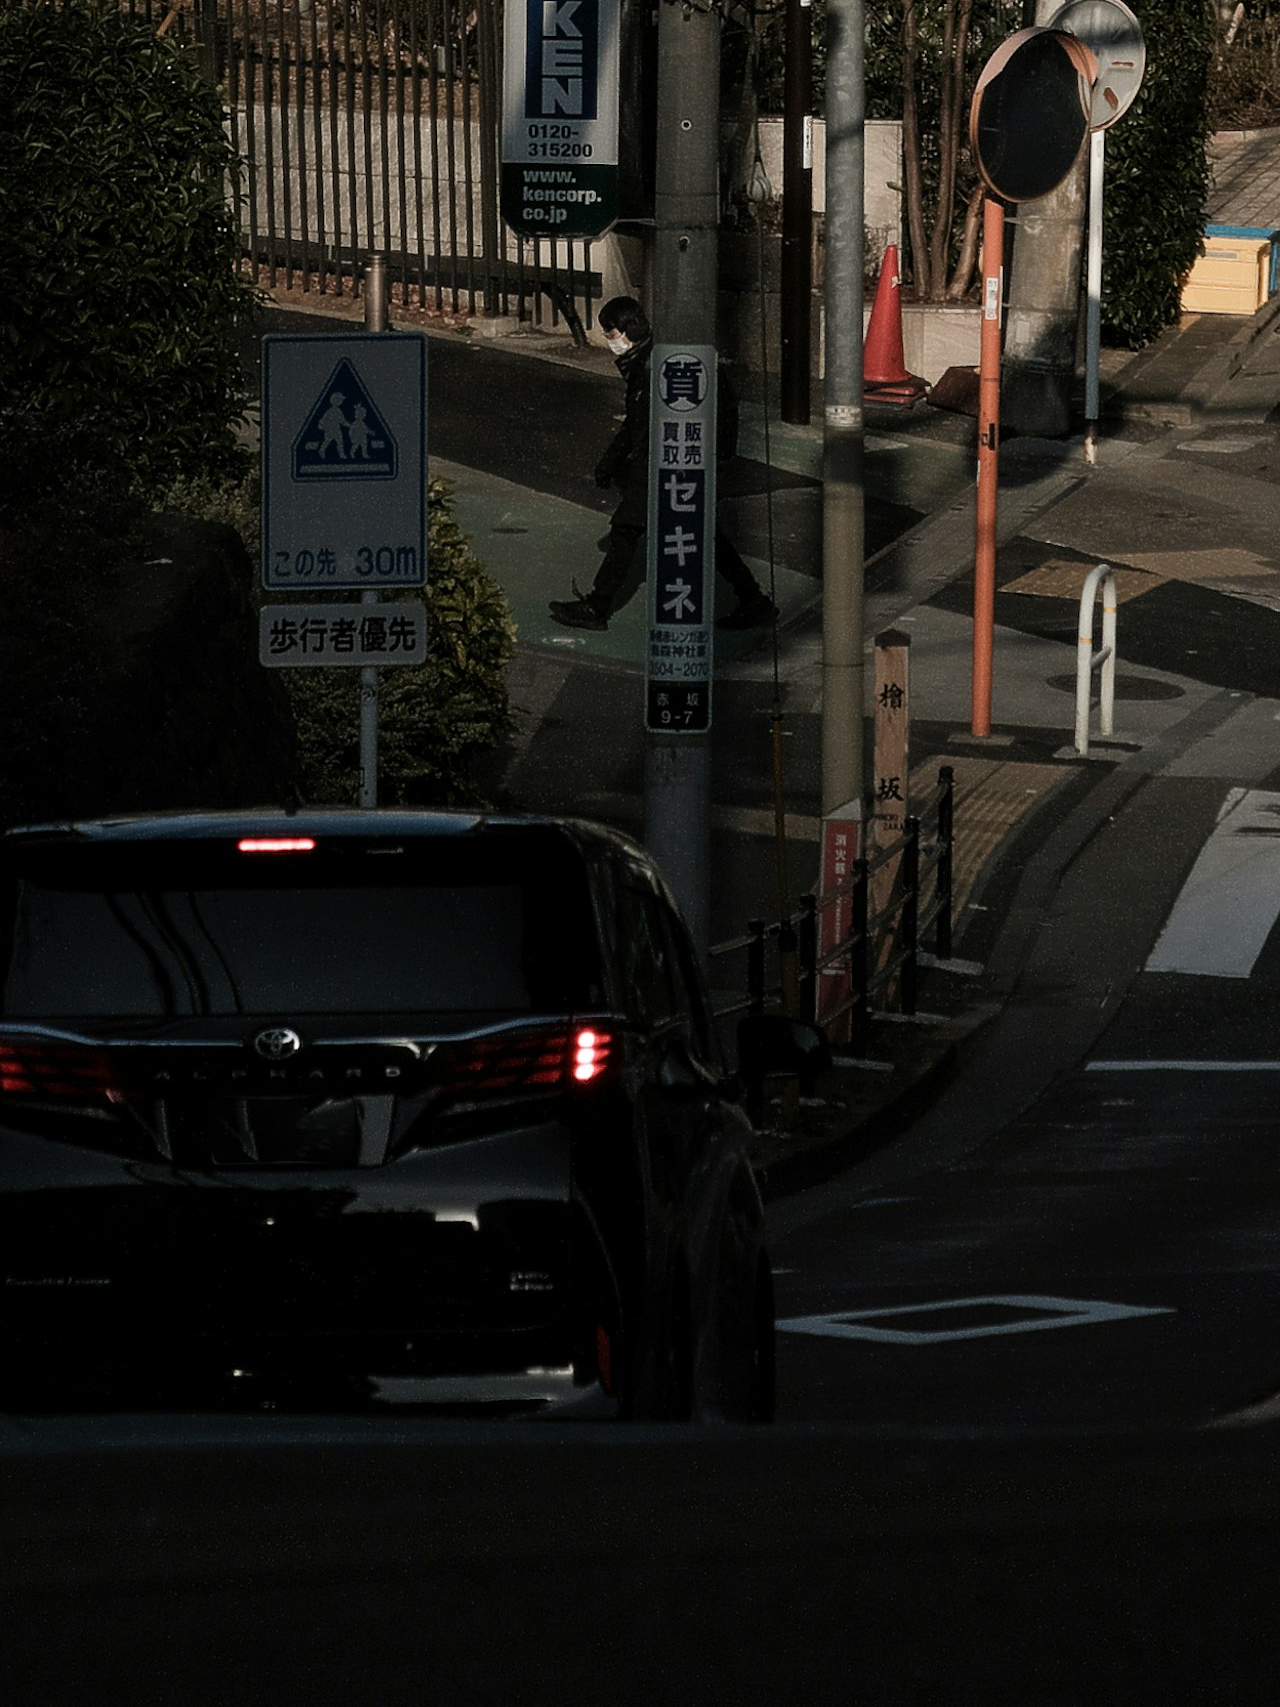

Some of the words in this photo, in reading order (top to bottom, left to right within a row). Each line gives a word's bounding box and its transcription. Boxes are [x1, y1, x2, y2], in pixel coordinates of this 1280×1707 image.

[540, 0, 584, 116] KEN
[528, 123, 579, 139] 0120-
[528, 142, 593, 157] 315200
[522, 169, 577, 184] www.
[522, 186, 602, 204] kencorp.
[522, 205, 568, 223] co.jp
[662, 361, 704, 407] 質
[662, 473, 699, 621] セキネ
[275, 548, 338, 578] この先
[355, 544, 417, 577] 30m
[269, 615, 417, 655] 歩行者優先
[656, 692, 701, 708] 赤坂
[659, 709, 694, 725] 9-7
